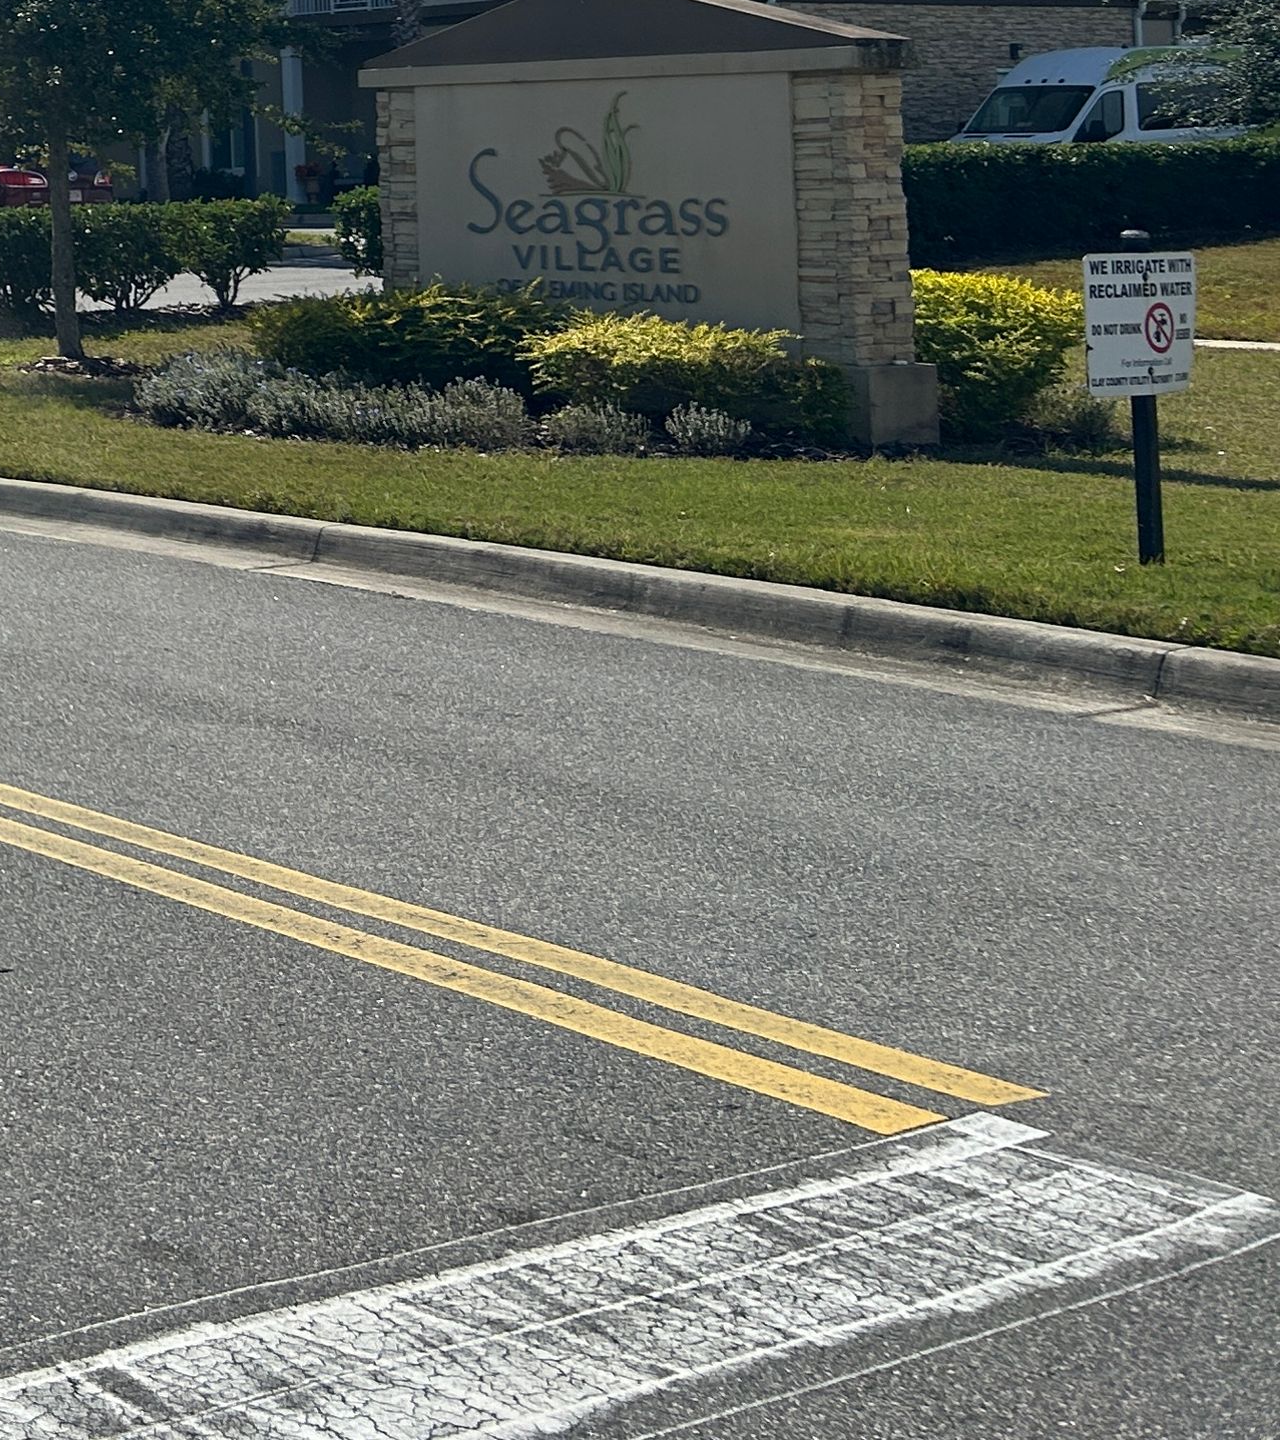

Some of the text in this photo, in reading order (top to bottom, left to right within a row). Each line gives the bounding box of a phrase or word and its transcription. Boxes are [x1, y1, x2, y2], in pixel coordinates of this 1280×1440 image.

[467, 148, 728, 254] Seagrass
[512, 245, 681, 274] VILLAGE
[1089, 258, 1192, 275] WE IRRIGATE WITH
[623, 283, 699, 304] ISLAND
[1089, 281, 1193, 299] RECLAIMED WATER
[1091, 323, 1142, 336] DO NOT DRINK
